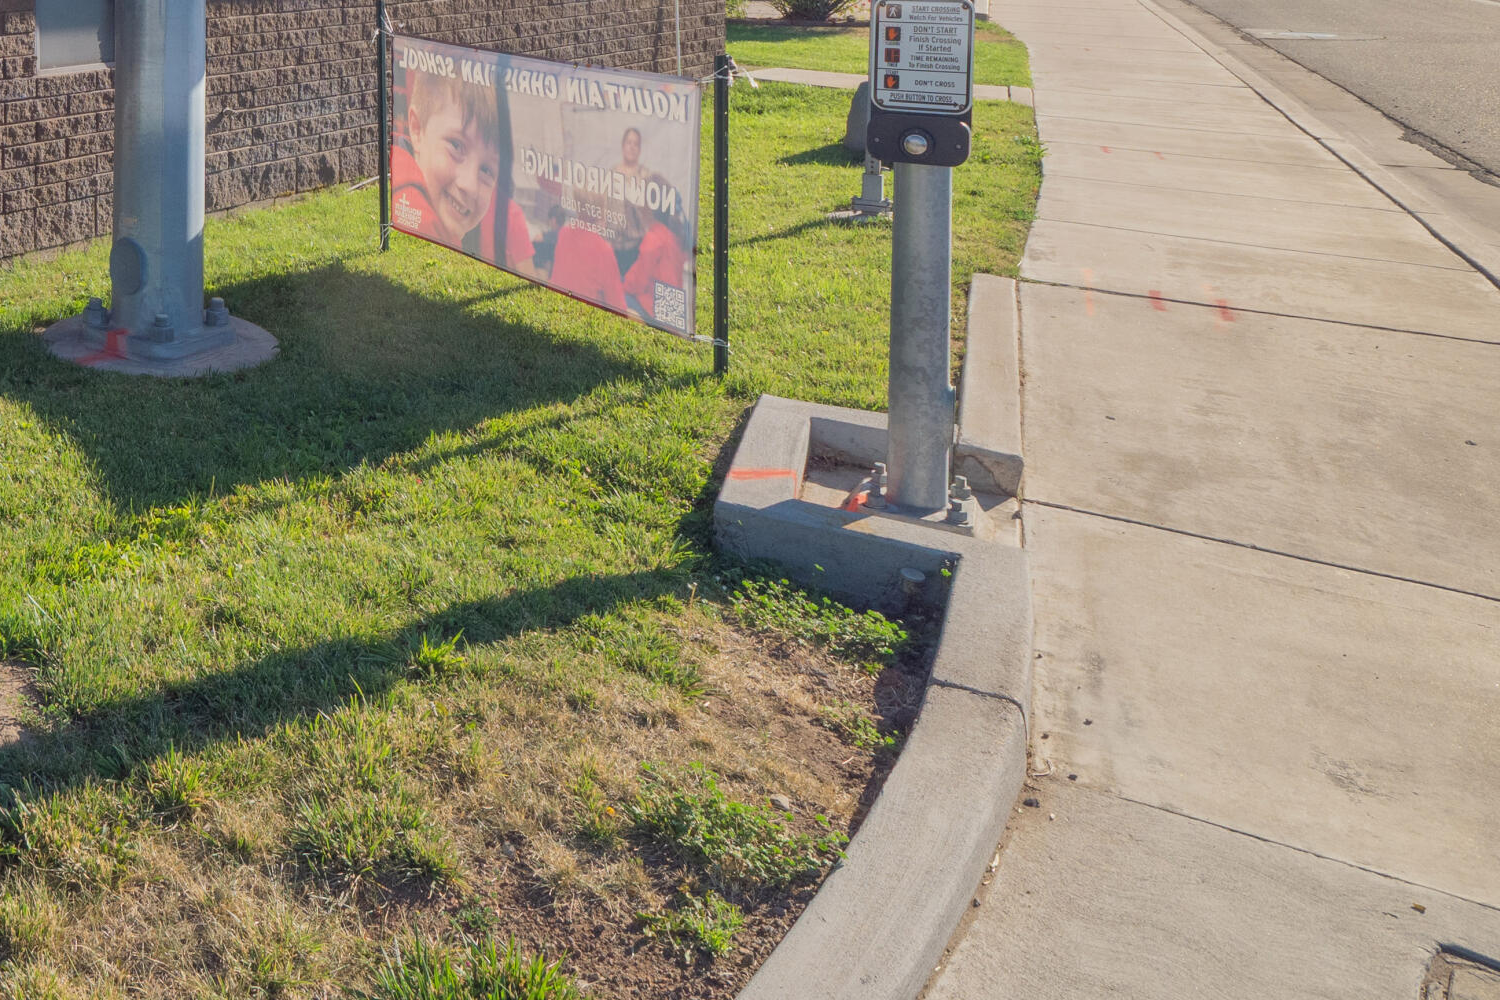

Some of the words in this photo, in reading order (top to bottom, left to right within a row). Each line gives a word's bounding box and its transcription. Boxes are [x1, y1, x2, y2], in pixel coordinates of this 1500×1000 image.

[931, 36, 962, 46] Crossing
[925, 44, 952, 52] Started
[926, 55, 959, 63] REMAINING
[935, 63, 960, 71] Crossing
[905, 93, 926, 101] BUTTON
[935, 95, 952, 103] CROSS
